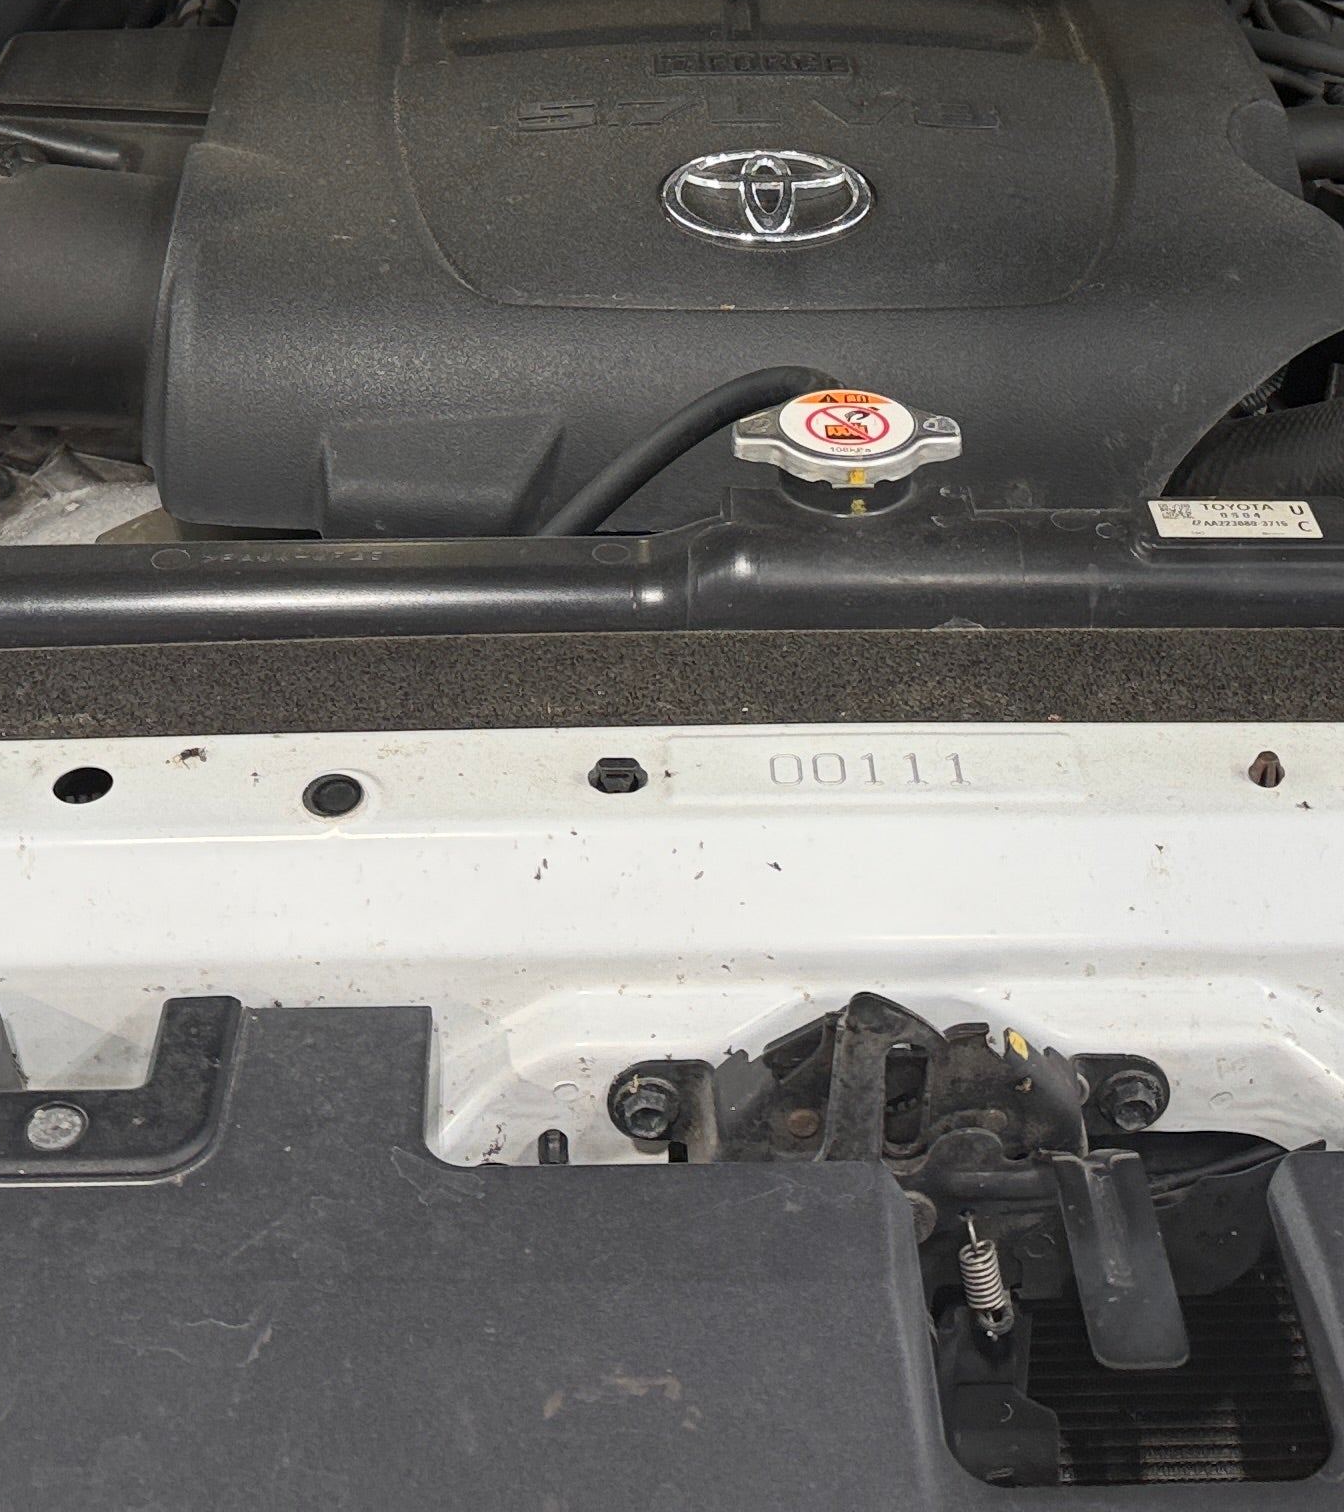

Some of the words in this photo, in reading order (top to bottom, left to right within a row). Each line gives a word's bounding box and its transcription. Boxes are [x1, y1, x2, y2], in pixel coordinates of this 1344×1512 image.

[1200, 503, 1274, 512] TOYOTA
[1288, 504, 1305, 516] U
[1297, 521, 1313, 533] C
[769, 752, 971, 786] 00111
